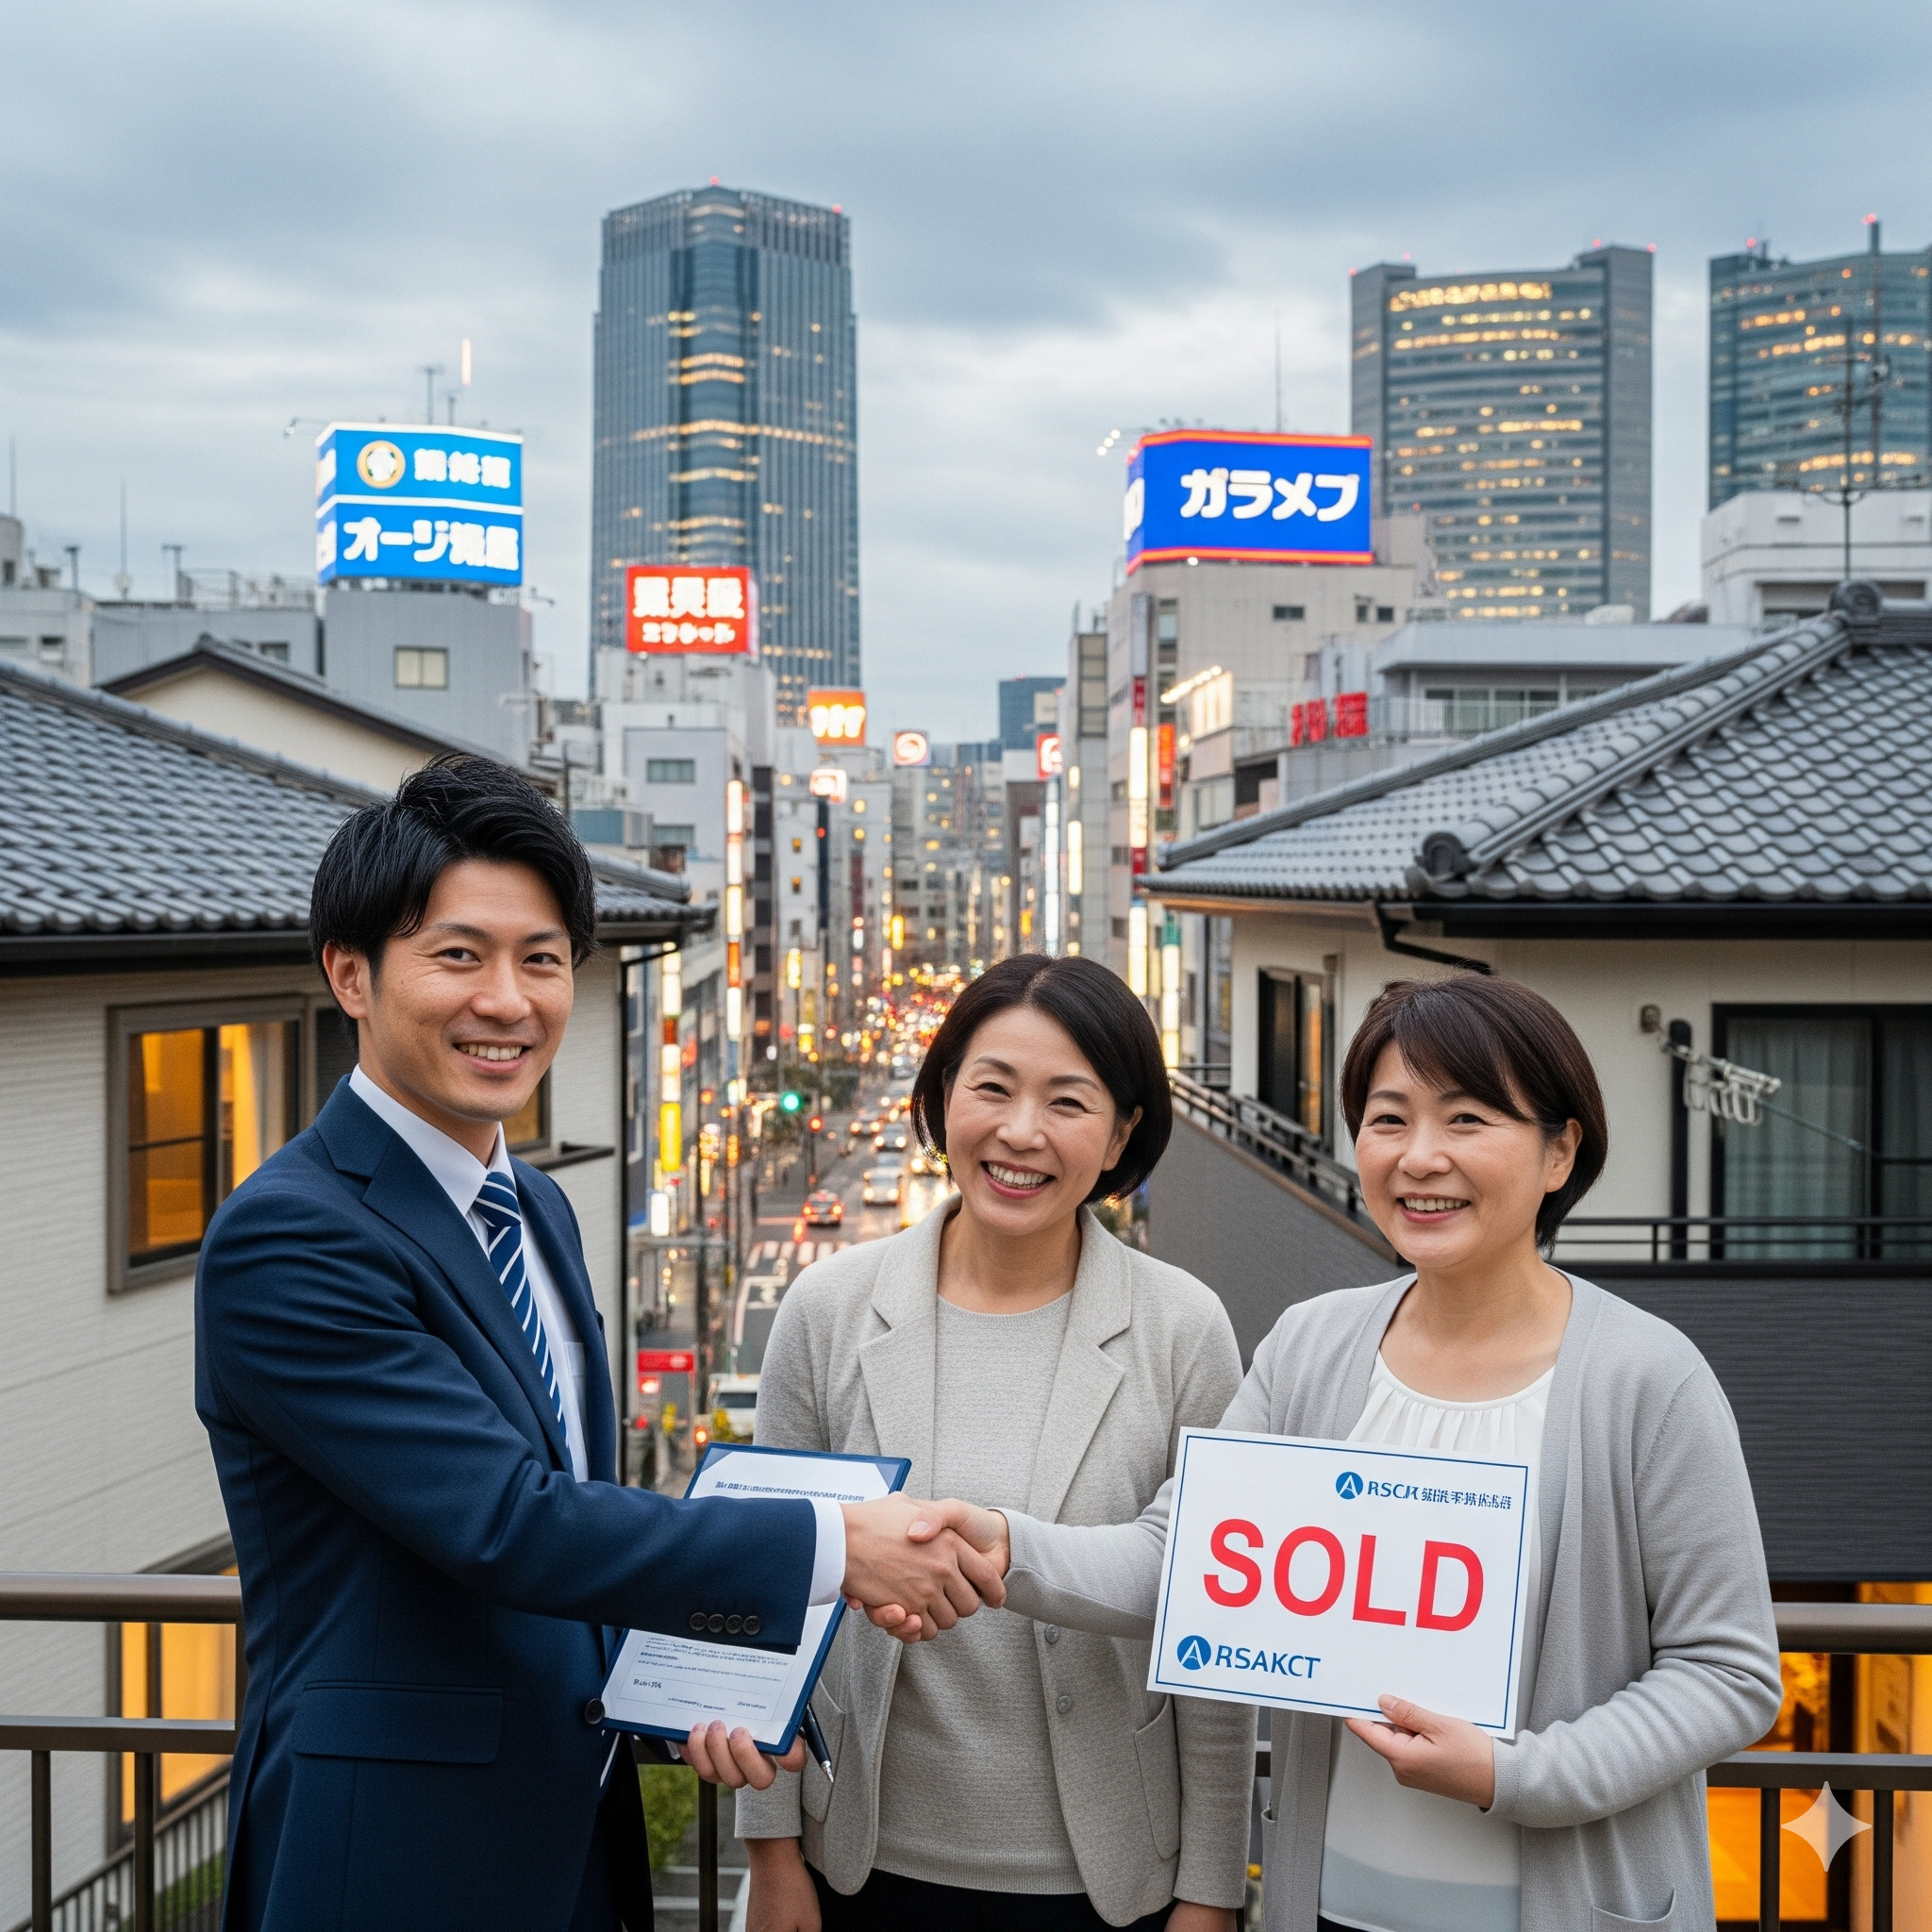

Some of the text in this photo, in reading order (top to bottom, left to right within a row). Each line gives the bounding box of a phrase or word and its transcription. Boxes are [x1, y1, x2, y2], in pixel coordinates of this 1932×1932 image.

[342, 516, 519, 571] オージ
[1203, 1518, 1485, 1632] SOLD
[1214, 1643, 1322, 1679] RSAKCT
